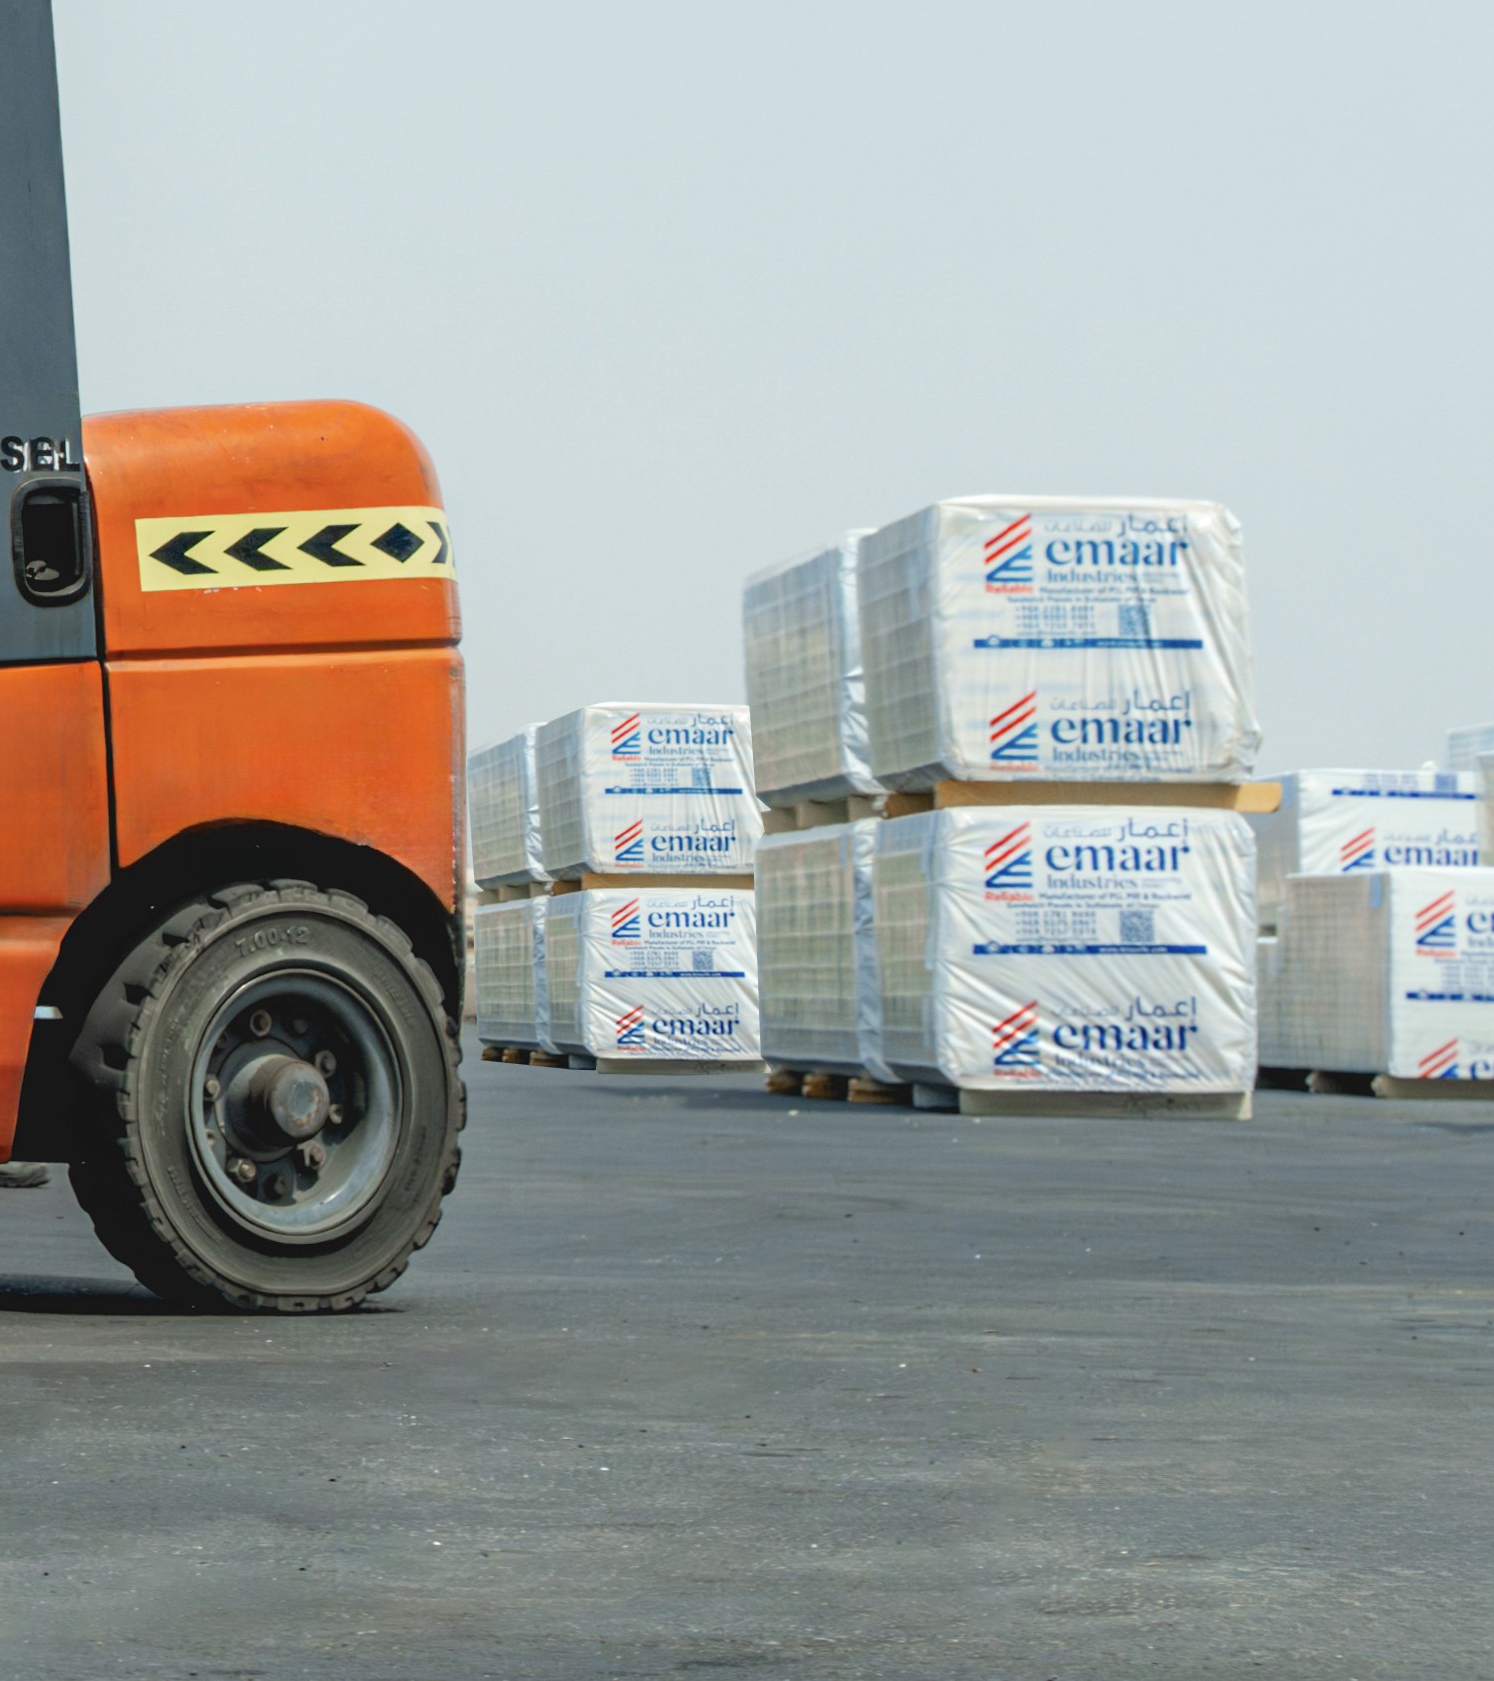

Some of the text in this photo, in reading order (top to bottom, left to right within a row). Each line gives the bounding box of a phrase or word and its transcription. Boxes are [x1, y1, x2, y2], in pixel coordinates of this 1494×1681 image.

[1043, 539, 1188, 566] emaar
[647, 728, 734, 745] emaar
[1050, 717, 1192, 745] emaar
[649, 835, 736, 852] emaar
[1043, 843, 1190, 871] emaar
[646, 910, 735, 928] emaar
[651, 1018, 740, 1036] emaar
[1051, 1023, 1198, 1051] emaar
